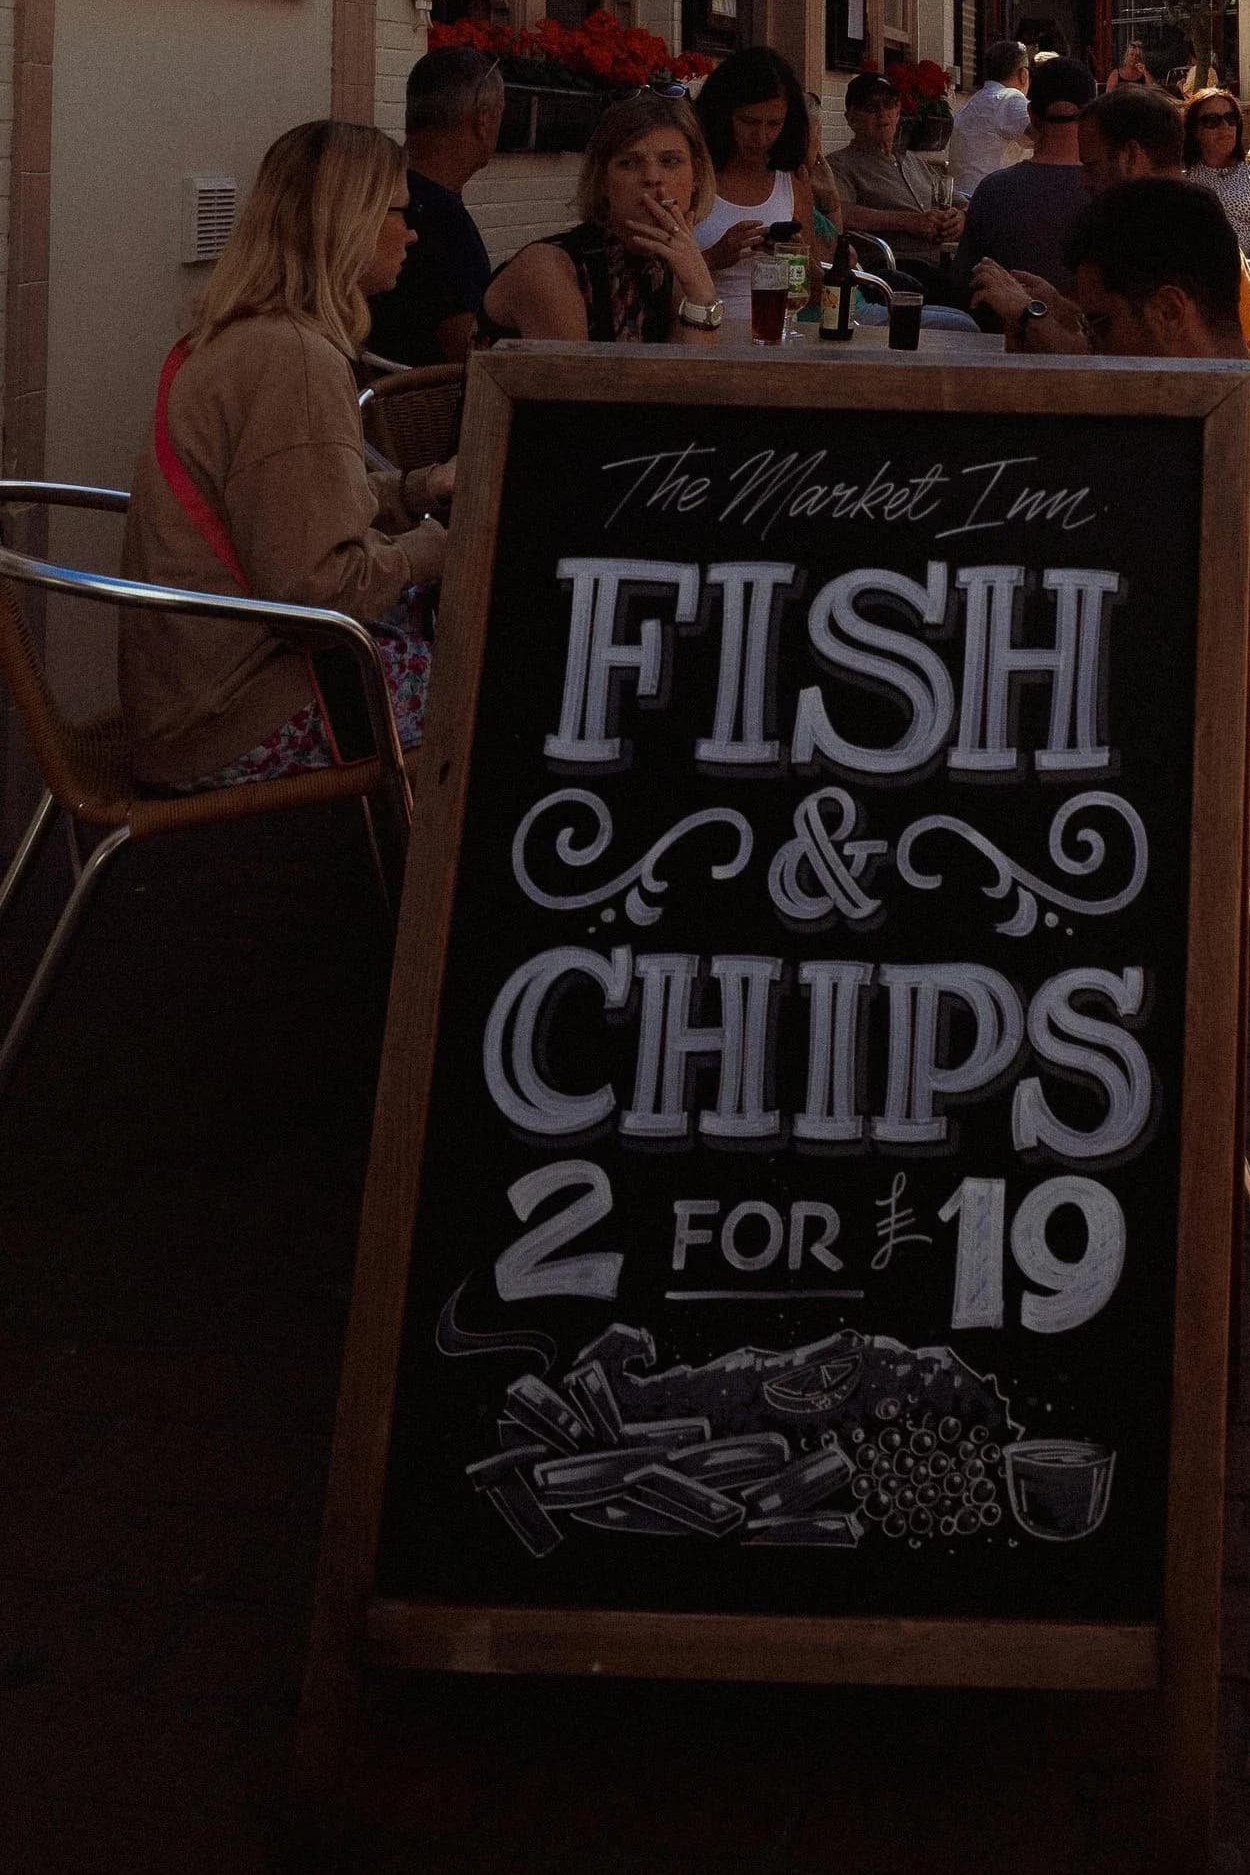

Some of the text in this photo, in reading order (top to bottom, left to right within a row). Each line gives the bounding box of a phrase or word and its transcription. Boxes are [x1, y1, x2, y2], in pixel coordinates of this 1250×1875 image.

[601, 442, 1097, 541] The Market Inn
[543, 557, 1119, 775] FISH
[768, 786, 890, 921] &
[482, 945, 1152, 1158] CHIPS
[494, 1159, 625, 1302] 2
[672, 1200, 845, 1272] FOR
